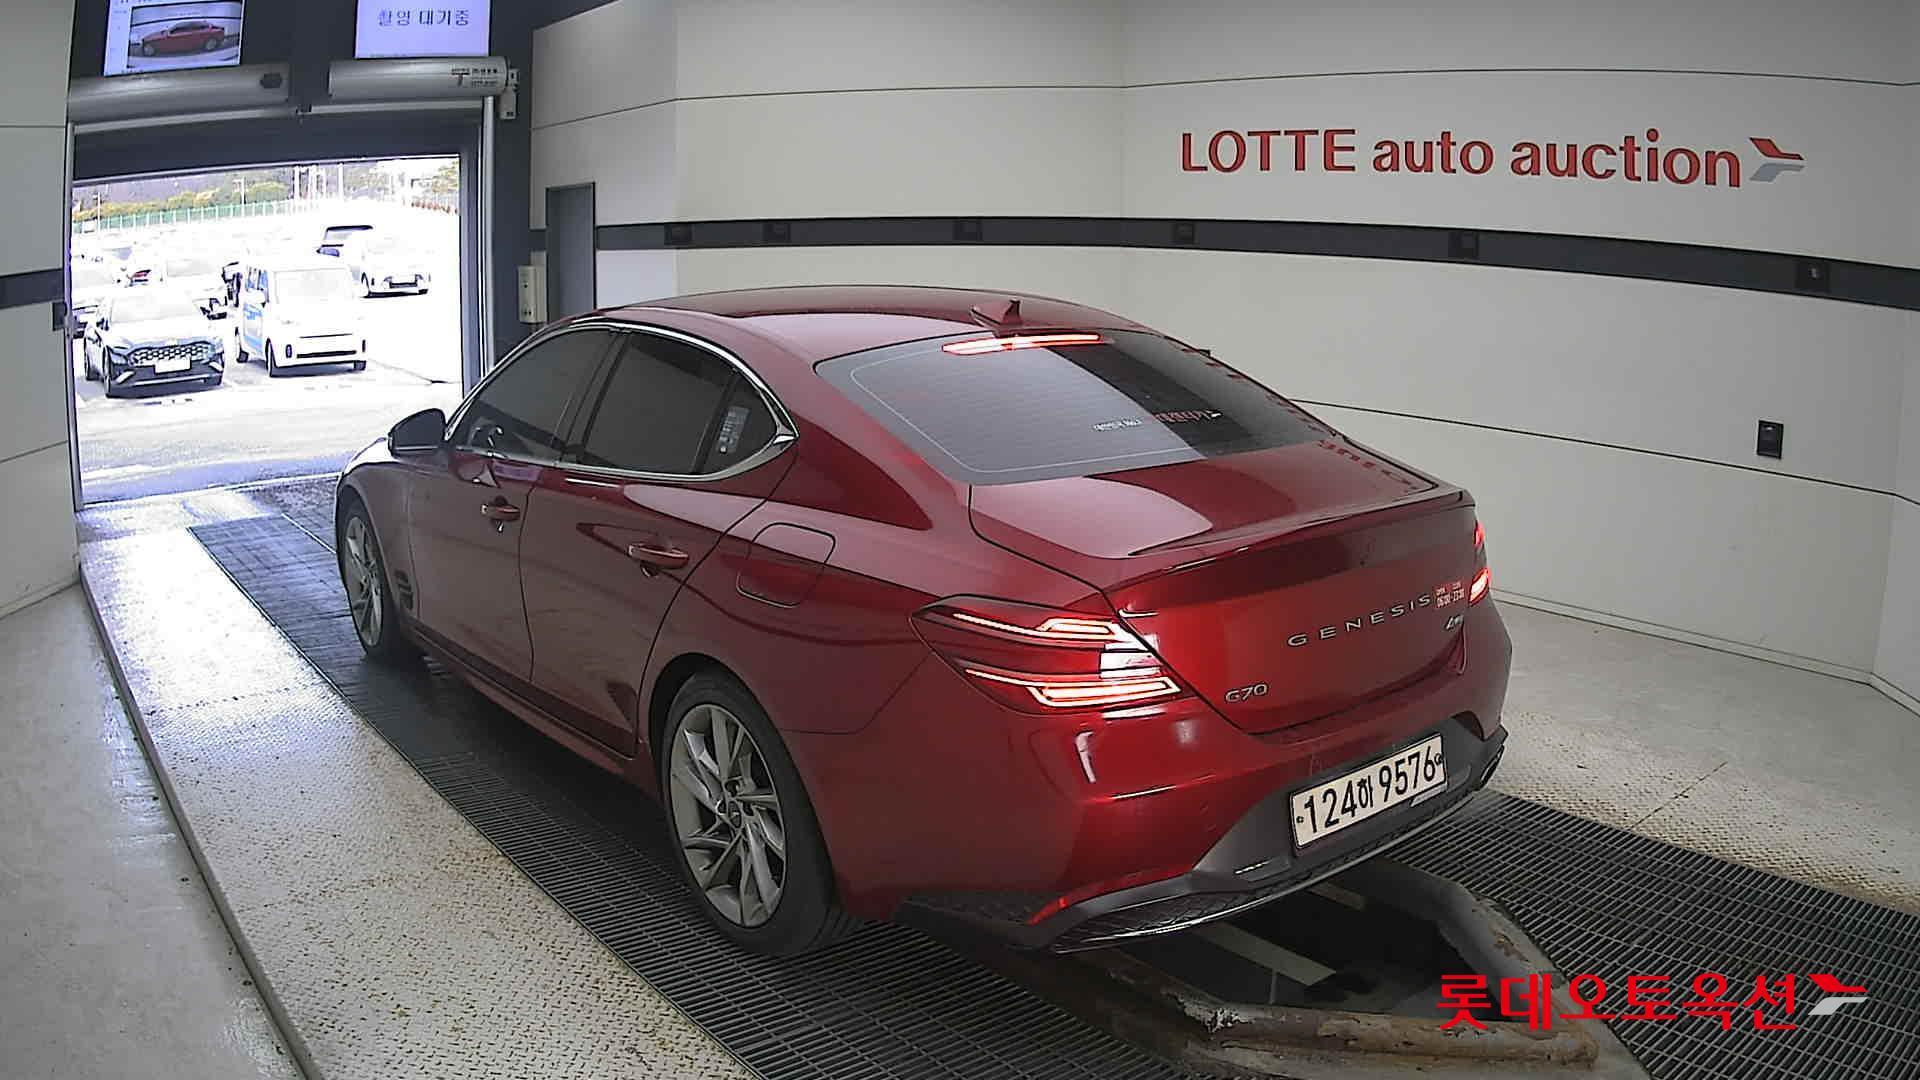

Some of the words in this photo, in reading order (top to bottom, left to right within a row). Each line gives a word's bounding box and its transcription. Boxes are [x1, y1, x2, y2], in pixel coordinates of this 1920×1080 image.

[418, 9, 469, 26] 대기중
[1182, 129, 1355, 173] LOTTE
[1373, 131, 1494, 175] auto
[1511, 128, 1741, 188] auction
[1287, 594, 1431, 647] GENESIS
[1224, 683, 1268, 702] G70
[1304, 775, 1374, 834] 124하
[1379, 746, 1436, 803] 9576
